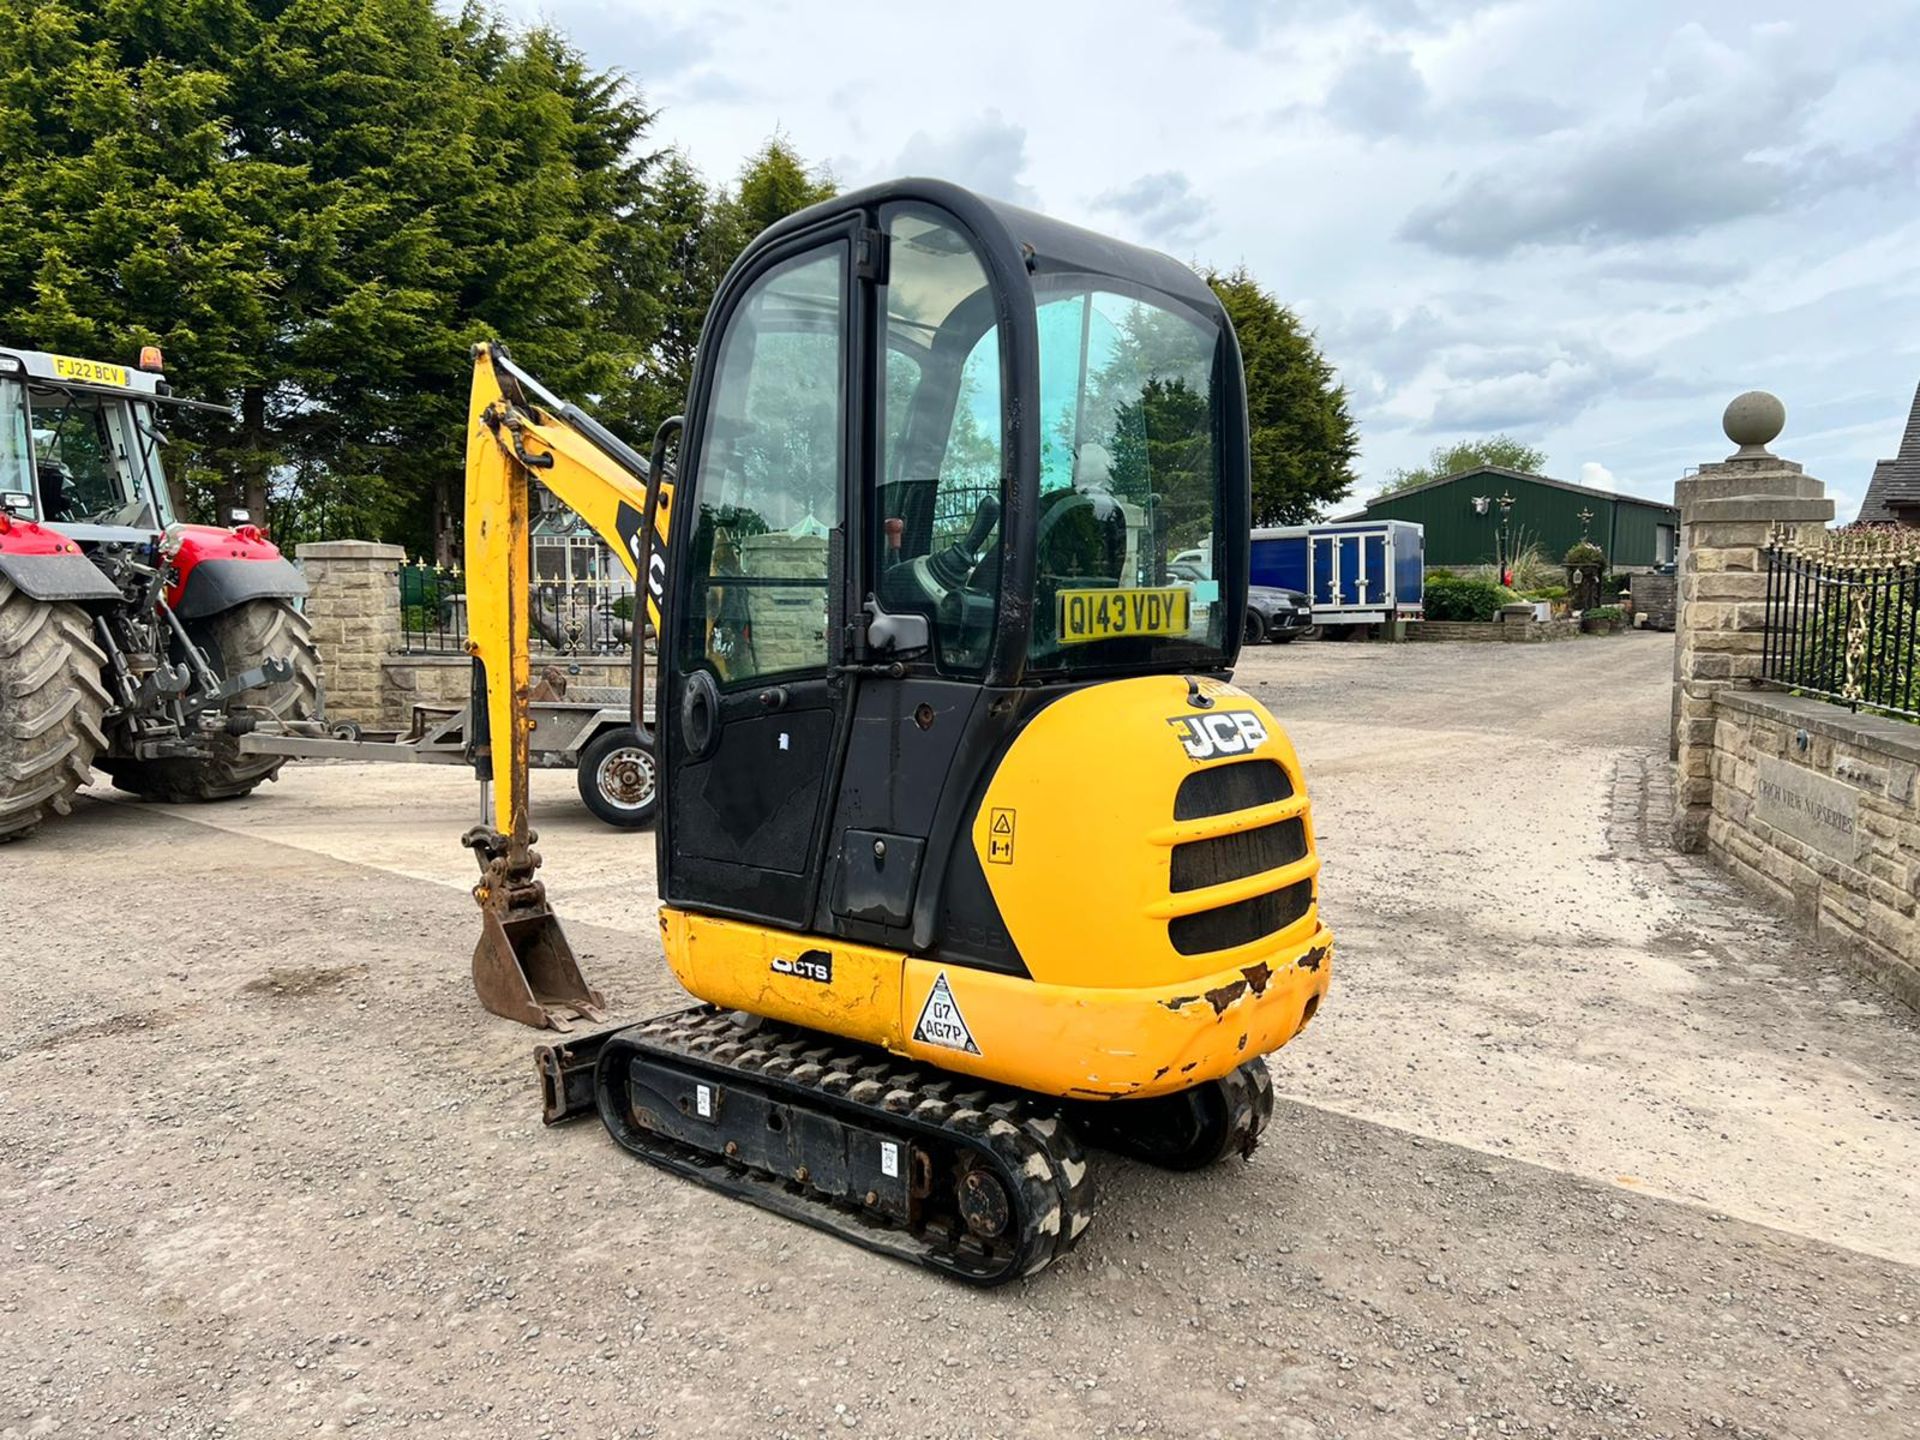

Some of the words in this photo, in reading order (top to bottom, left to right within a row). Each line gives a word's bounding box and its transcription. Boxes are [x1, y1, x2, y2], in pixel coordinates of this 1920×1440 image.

[57, 359, 92, 378] FJ22
[95, 365, 118, 382] BCV
[1069, 595, 1126, 634] Q143
[1133, 593, 1174, 632] VDY
[1183, 712, 1268, 758] JCB
[926, 1019, 962, 1041] AG7P
